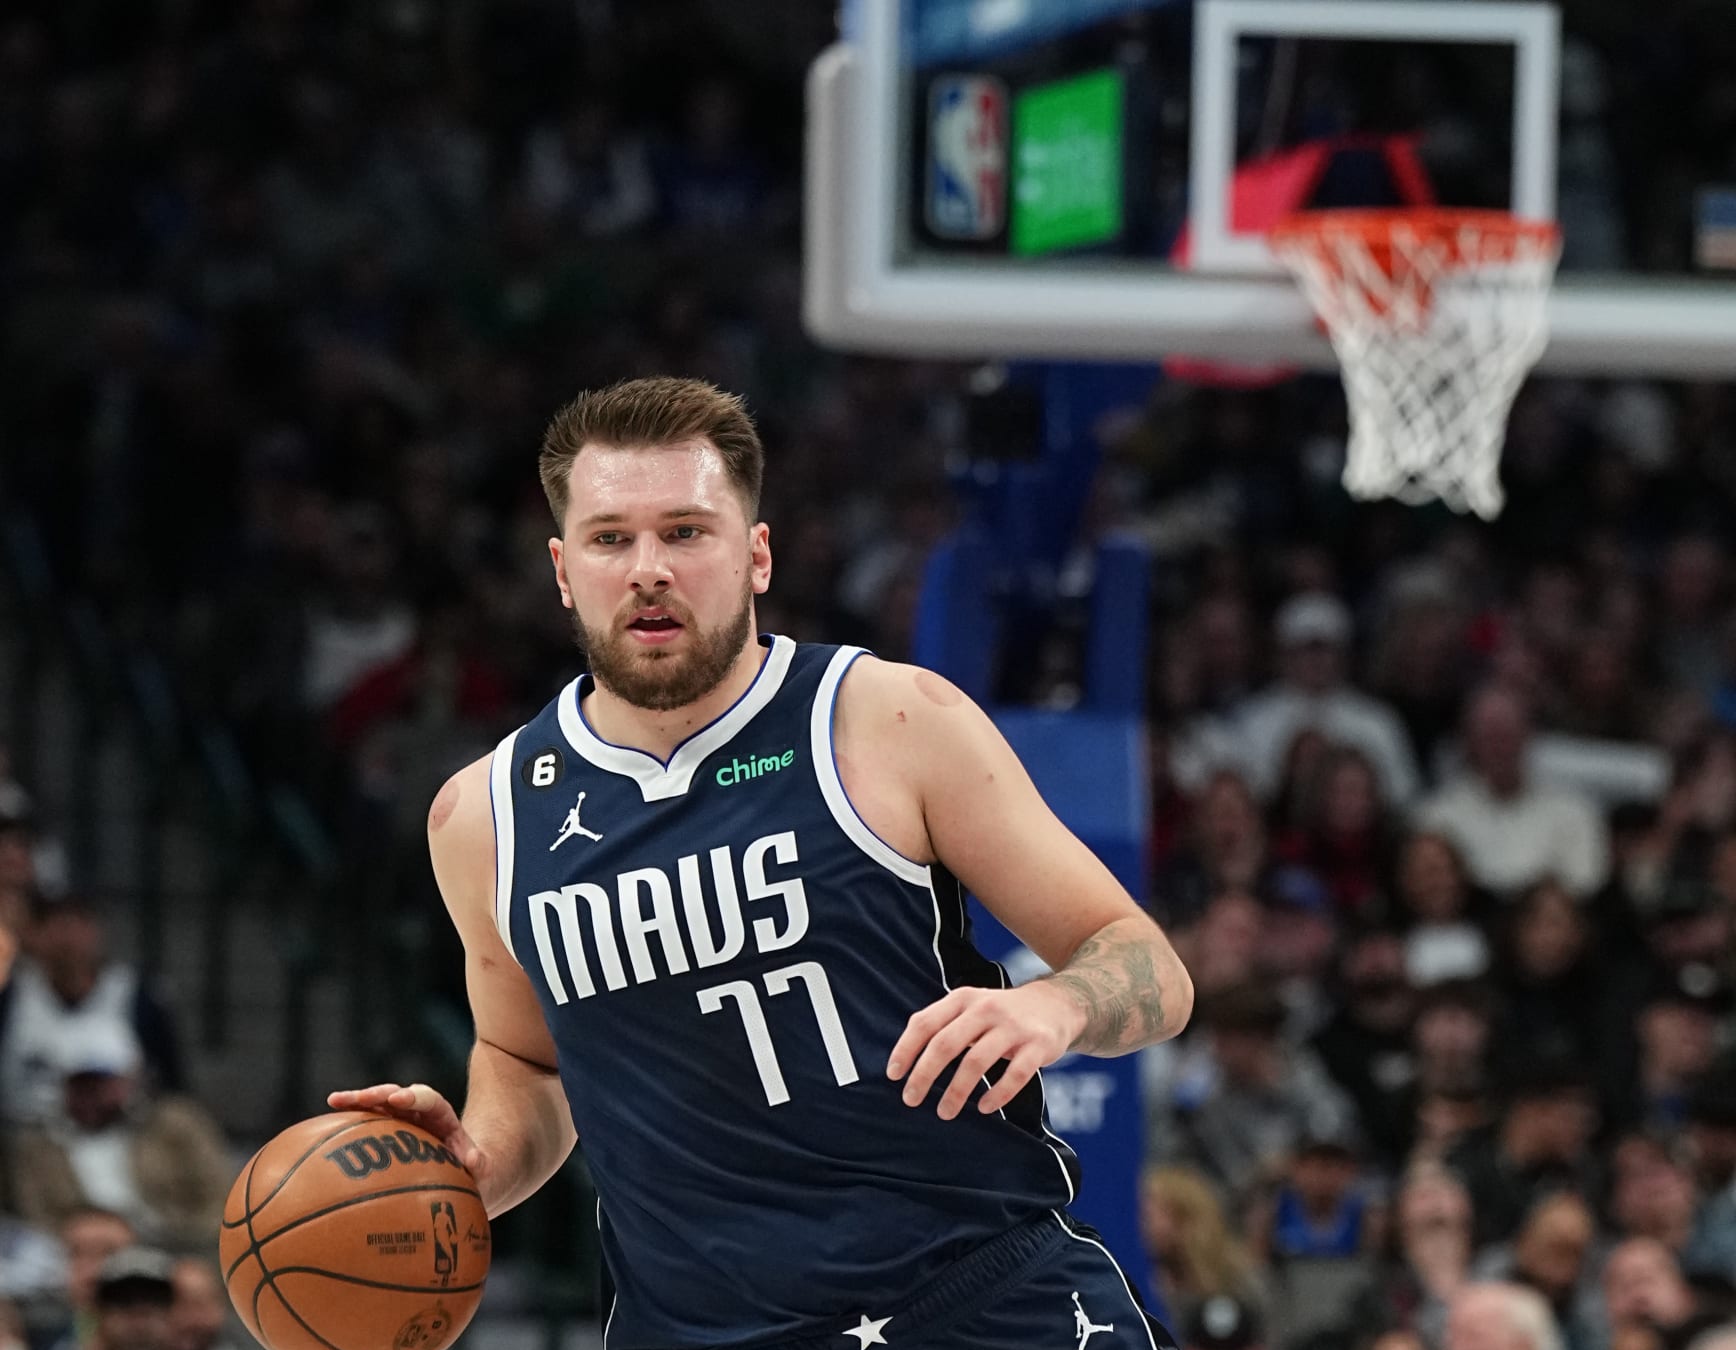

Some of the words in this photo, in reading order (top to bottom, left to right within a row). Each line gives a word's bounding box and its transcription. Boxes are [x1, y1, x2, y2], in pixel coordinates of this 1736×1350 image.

[532, 753, 556, 787] 6
[715, 748, 795, 787] chime
[527, 830, 810, 1006] MAVS
[696, 961, 860, 1107] 77
[325, 1130, 465, 1180] Wilso
